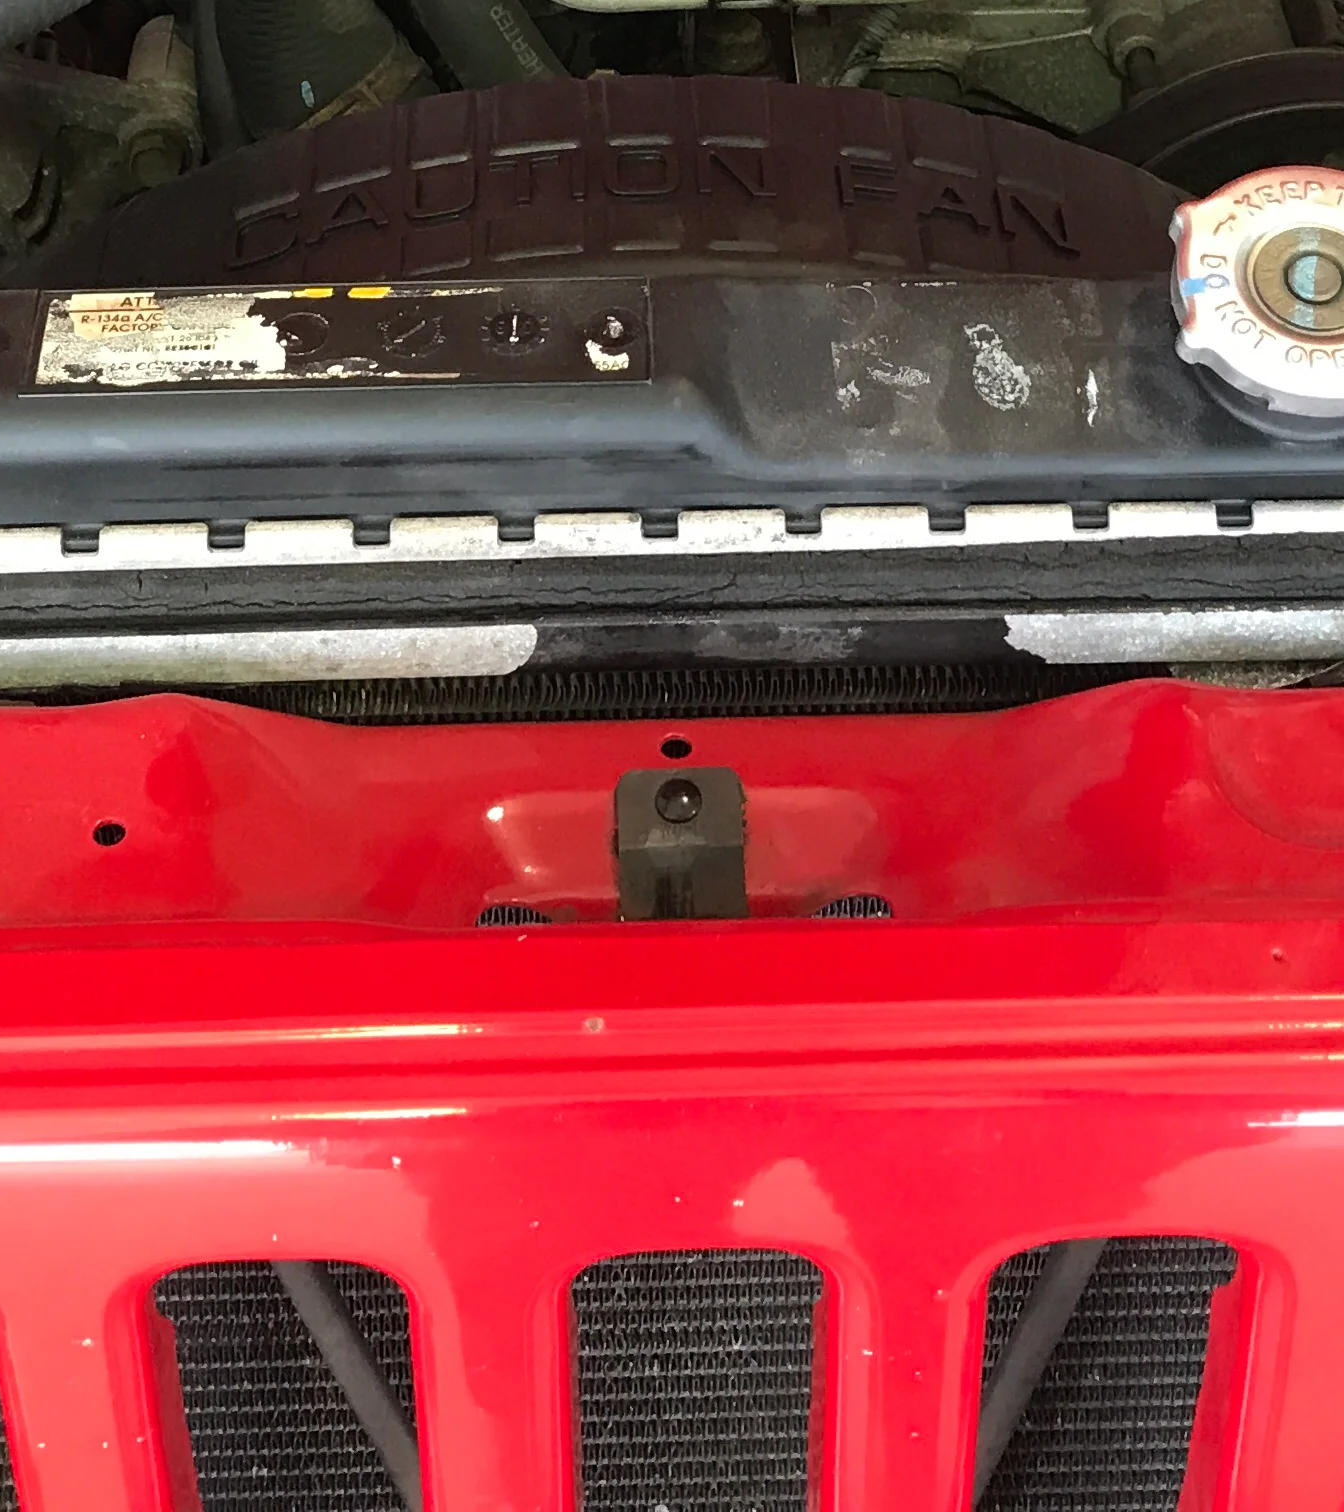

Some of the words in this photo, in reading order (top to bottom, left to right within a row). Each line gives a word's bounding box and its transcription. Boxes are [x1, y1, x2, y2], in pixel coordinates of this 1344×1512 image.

[490, 3, 546, 78] HEATER
[228, 148, 777, 269] CAUTION
[838, 158, 1083, 262] FAN
[1233, 180, 1325, 217] KEEP
[1200, 253, 1230, 290] DO
[81, 313, 131, 324] R-134a
[134, 311, 164, 324] A/C
[120, 295, 160, 308] ATT
[1214, 299, 1277, 349] NOT
